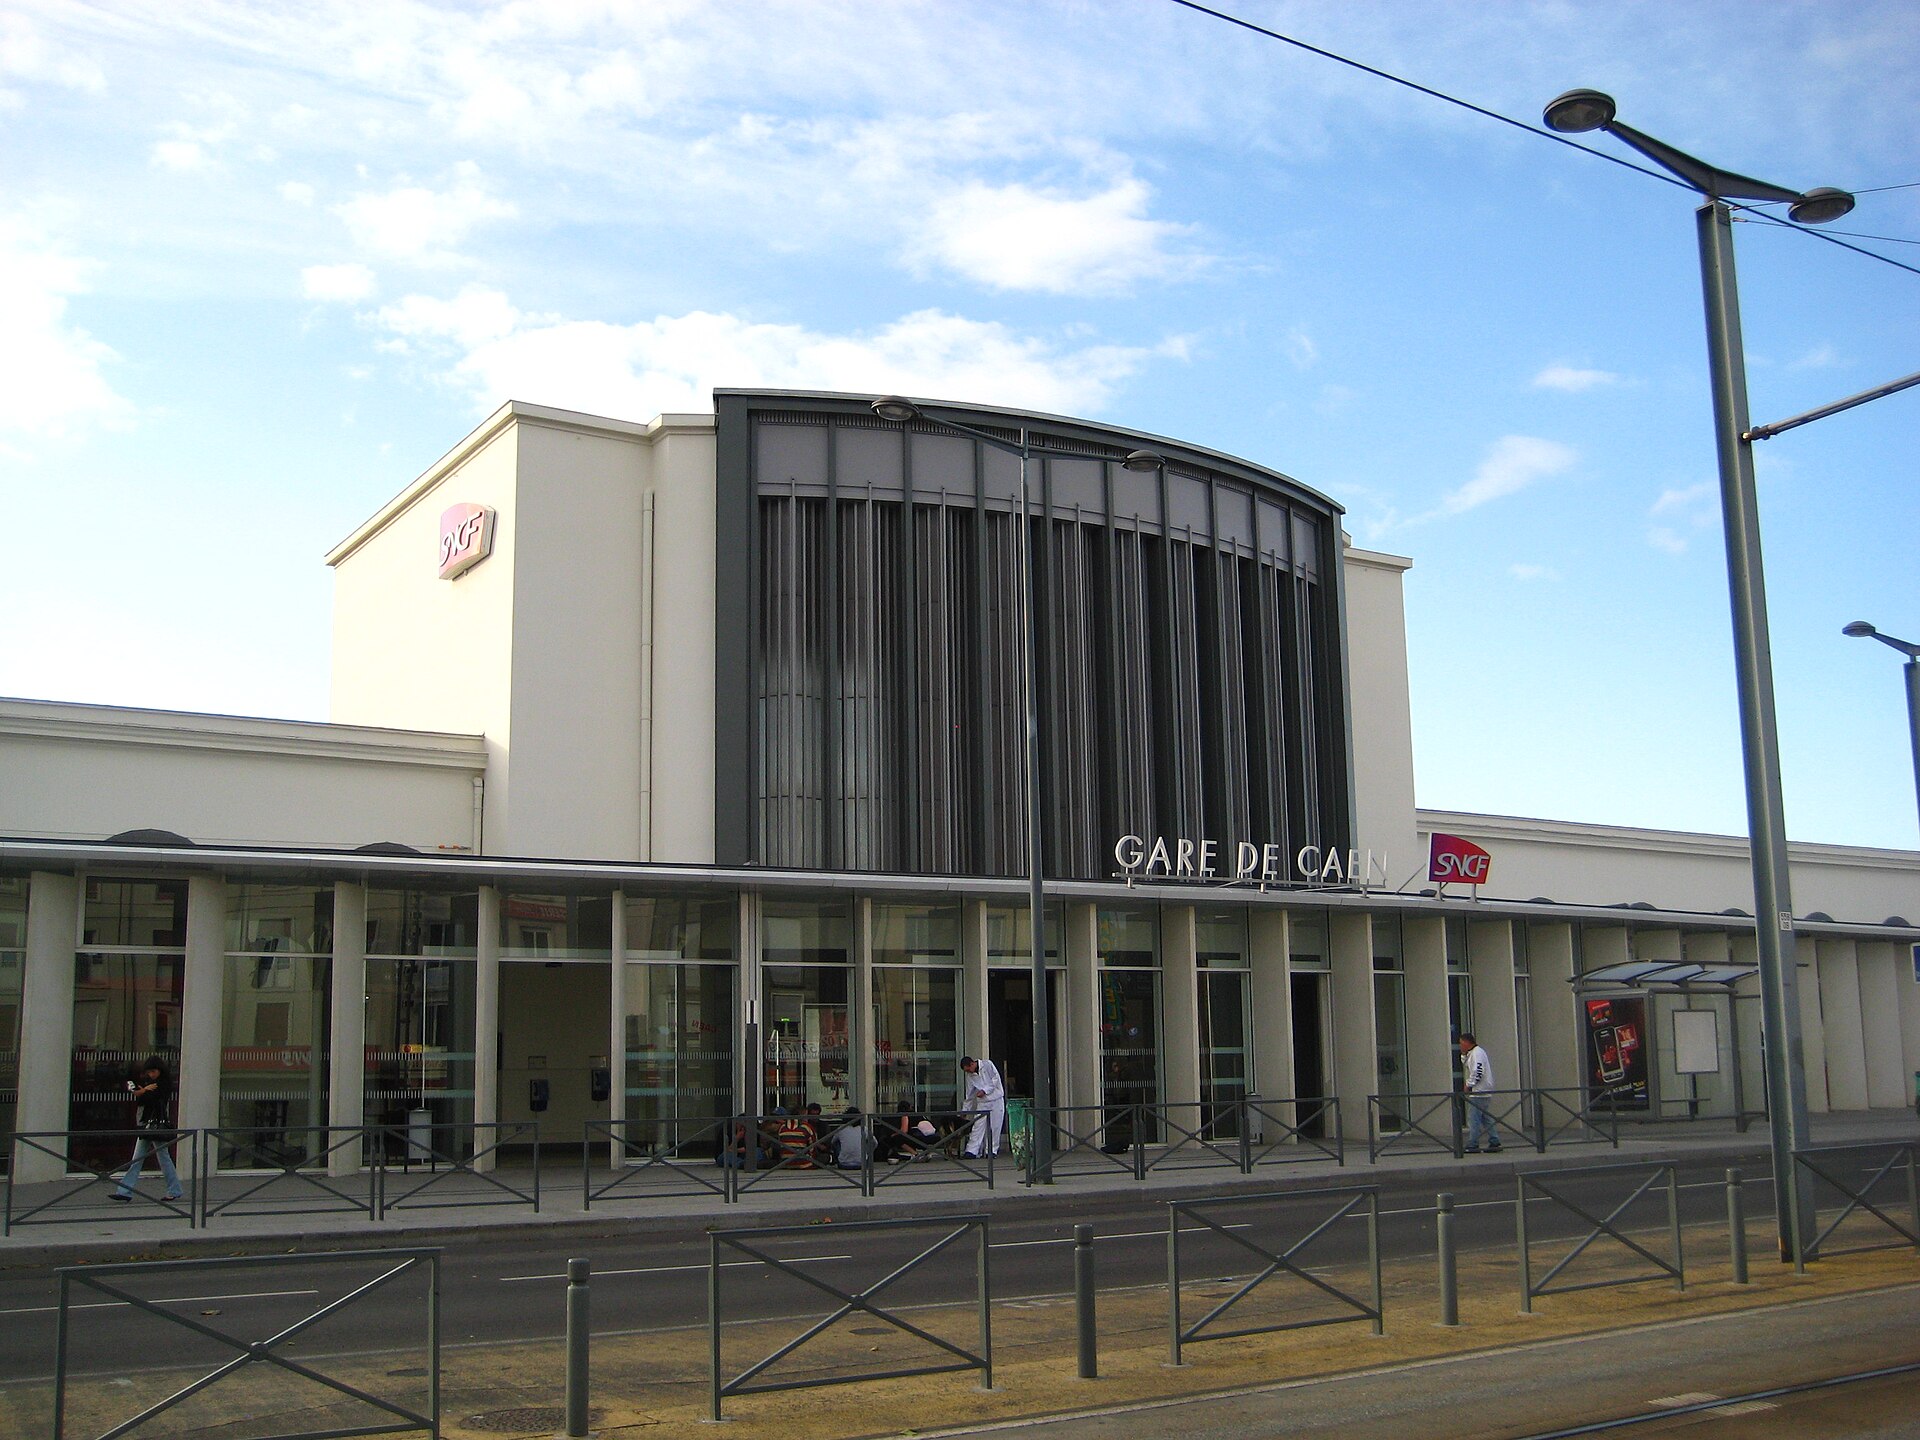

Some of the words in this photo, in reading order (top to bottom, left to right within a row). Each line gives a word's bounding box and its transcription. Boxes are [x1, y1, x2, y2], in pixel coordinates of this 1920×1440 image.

[439, 511, 483, 568] SNCF
[1114, 835, 1217, 872] GARE
[1237, 841, 1279, 875] DE
[1297, 845, 1388, 880] CAEN
[1433, 852, 1490, 878] SNCF
